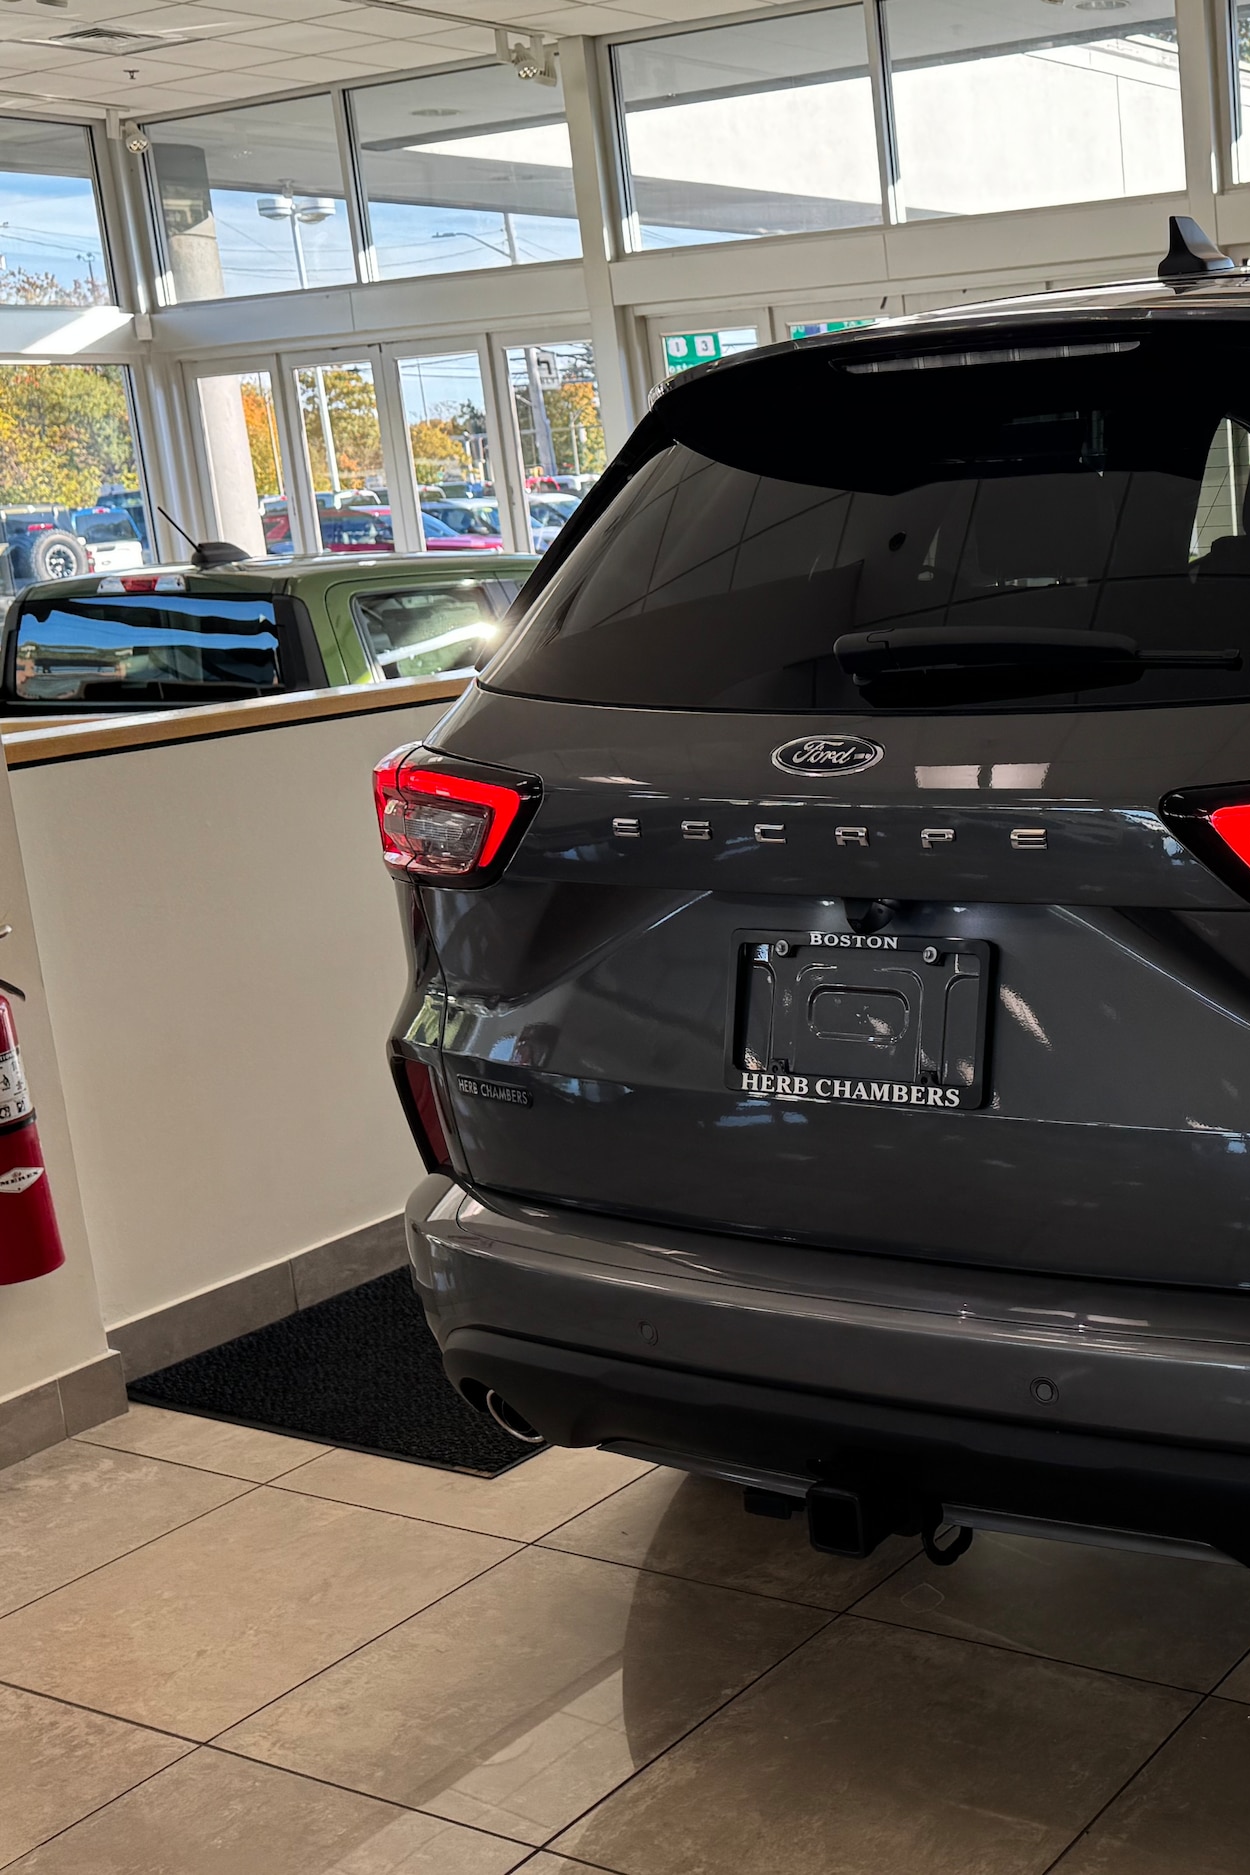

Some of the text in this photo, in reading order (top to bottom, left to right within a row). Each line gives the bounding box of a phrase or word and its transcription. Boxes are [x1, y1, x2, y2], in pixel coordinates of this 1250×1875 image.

[792, 740, 857, 765] Ford
[612, 816, 1048, 850] ESCAPE
[809, 932, 899, 950] BOSTON
[457, 1078, 528, 1105] HERB CHAMBERS
[741, 1072, 961, 1108] HERB CHAMBERS
